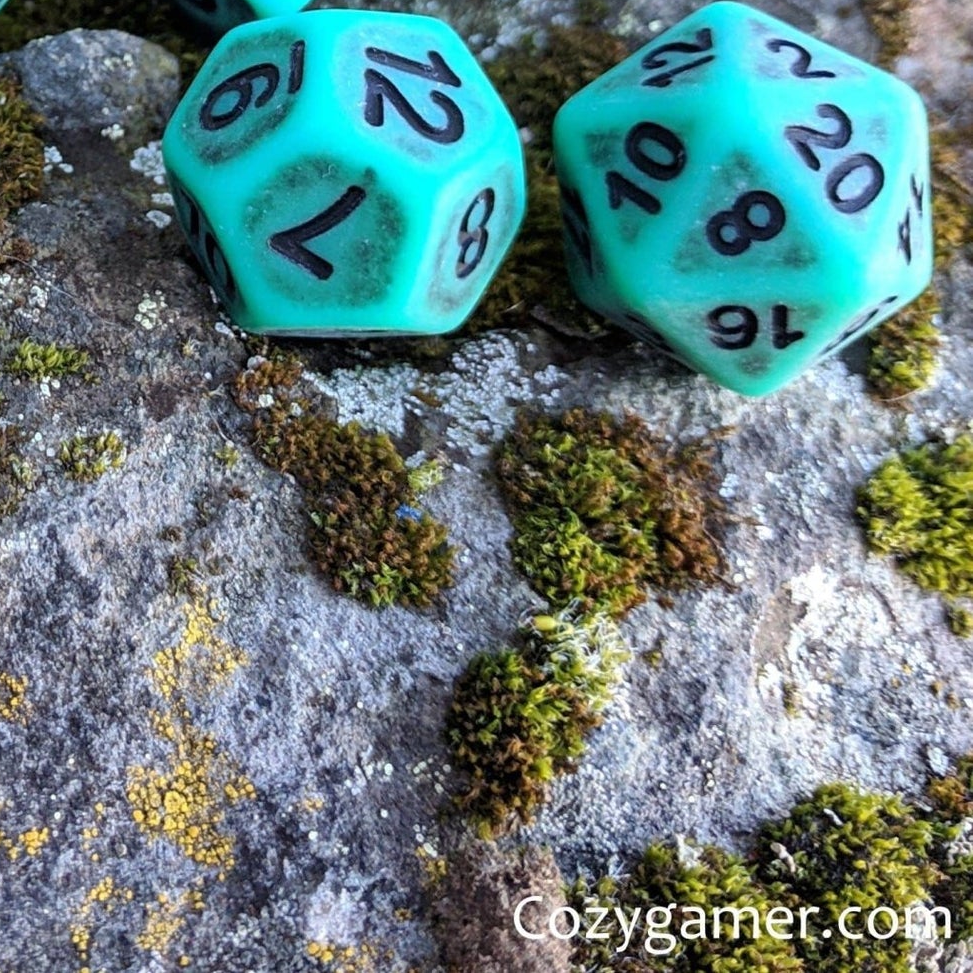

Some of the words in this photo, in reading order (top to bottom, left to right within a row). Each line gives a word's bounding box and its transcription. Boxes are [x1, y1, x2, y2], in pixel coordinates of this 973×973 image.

[363, 46, 465, 144] 12
[640, 27, 715, 88] 12
[766, 38, 836, 79] 2
[604, 121, 687, 216] 10
[784, 103, 884, 215] 20
[267, 184, 367, 281] 7
[455, 187, 495, 279] 8
[705, 190, 786, 257] 8
[704, 304, 804, 350] 16
